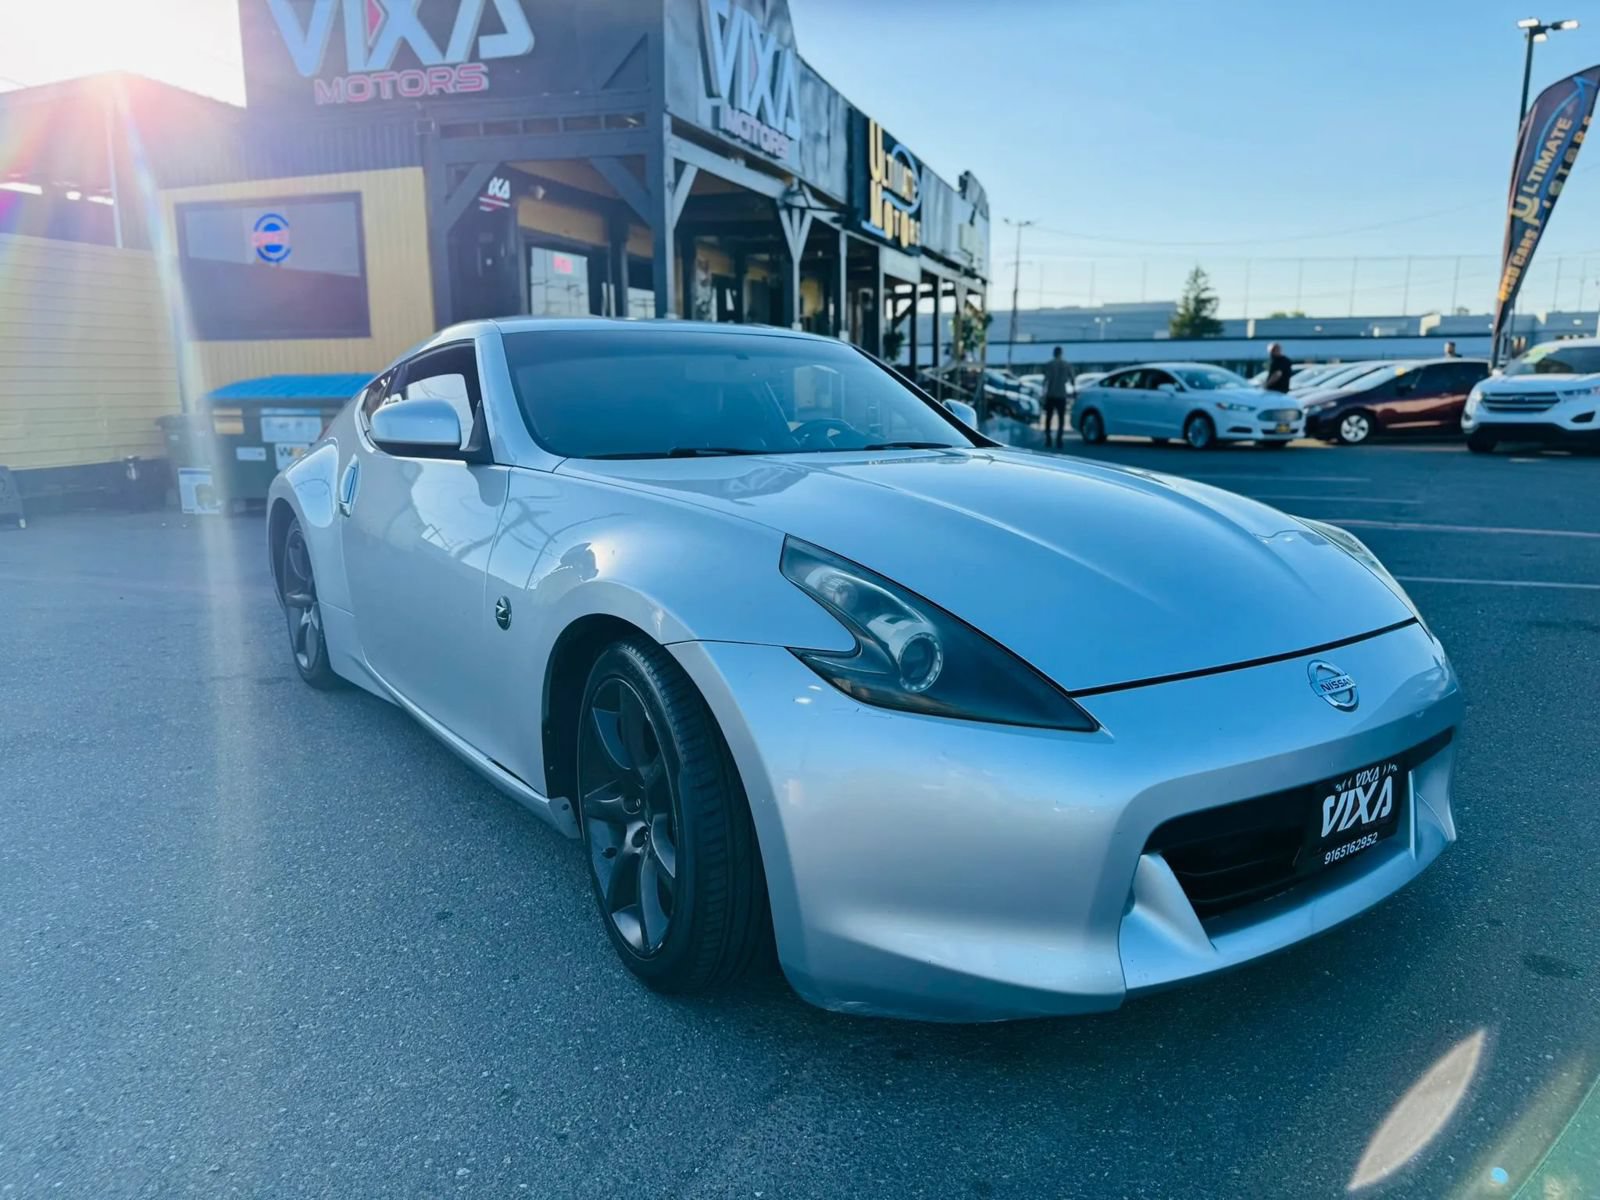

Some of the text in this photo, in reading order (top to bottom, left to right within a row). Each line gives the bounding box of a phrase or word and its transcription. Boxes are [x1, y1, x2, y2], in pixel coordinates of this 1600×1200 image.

[268, 0, 535, 77] VIXA
[313, 63, 488, 105] MOTORS
[706, 0, 800, 141] VIXA
[722, 105, 789, 160] MOTORS
[1509, 117, 1573, 224] ULTIMATE
[1320, 676, 1355, 693] NISSAN
[1355, 766, 1380, 788] VIXA
[1321, 775, 1393, 838] VIXA
[1324, 831, 1378, 865] 9165162952
